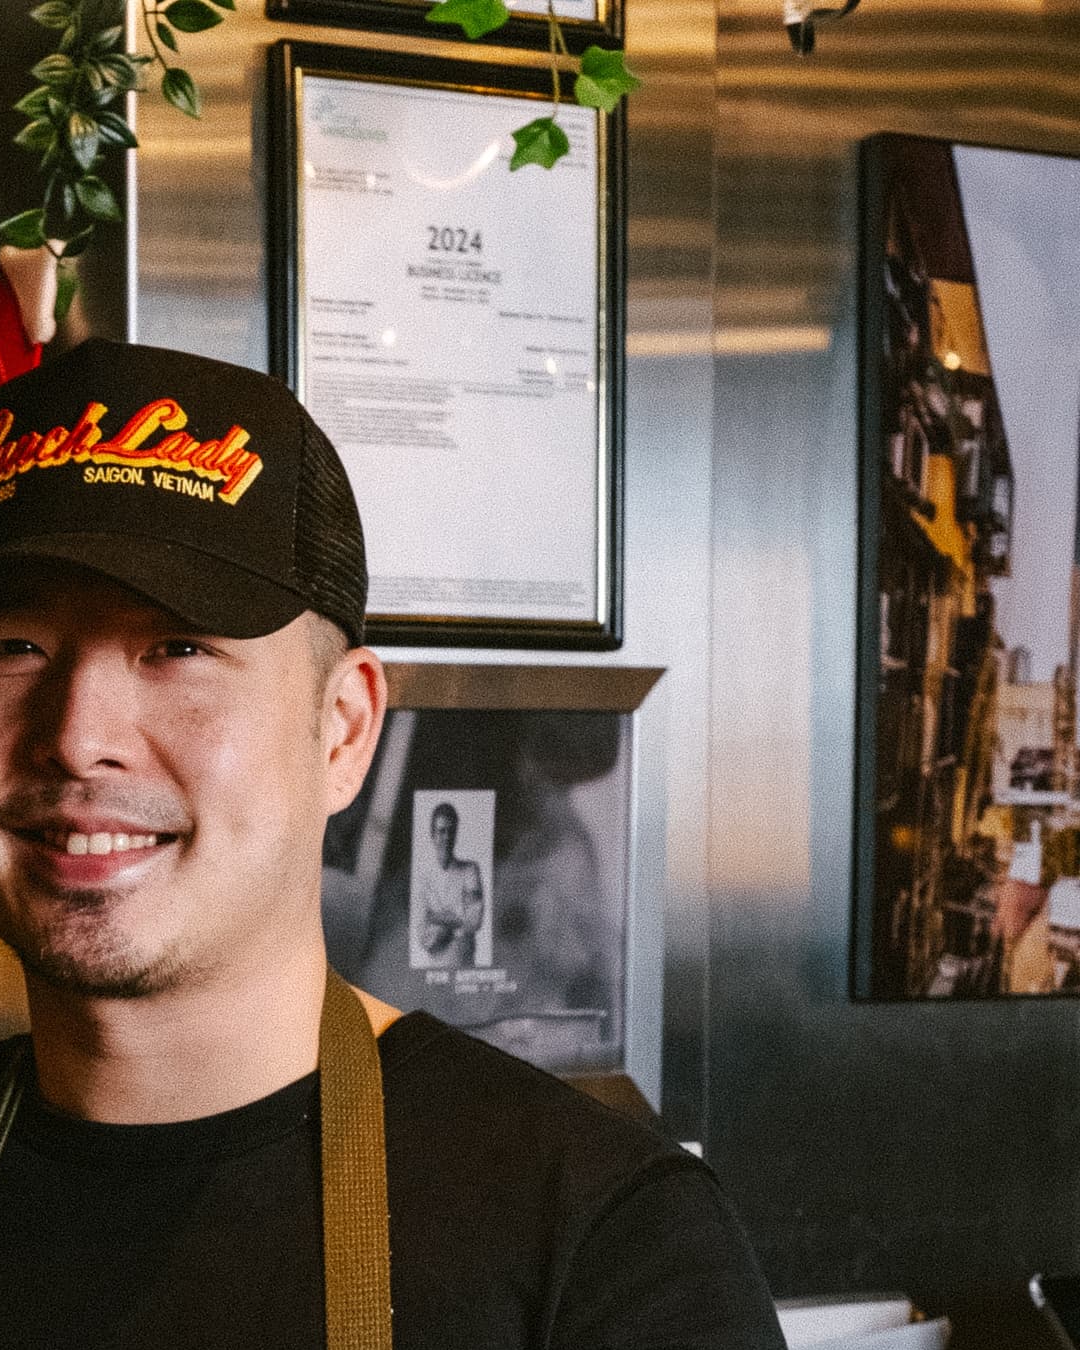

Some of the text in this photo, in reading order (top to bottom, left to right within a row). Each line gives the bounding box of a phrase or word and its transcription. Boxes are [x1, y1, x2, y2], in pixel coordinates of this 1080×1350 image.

[427, 225, 482, 253] 2024
[90, 397, 264, 506] Lady
[152, 470, 215, 502] VIETNAM
